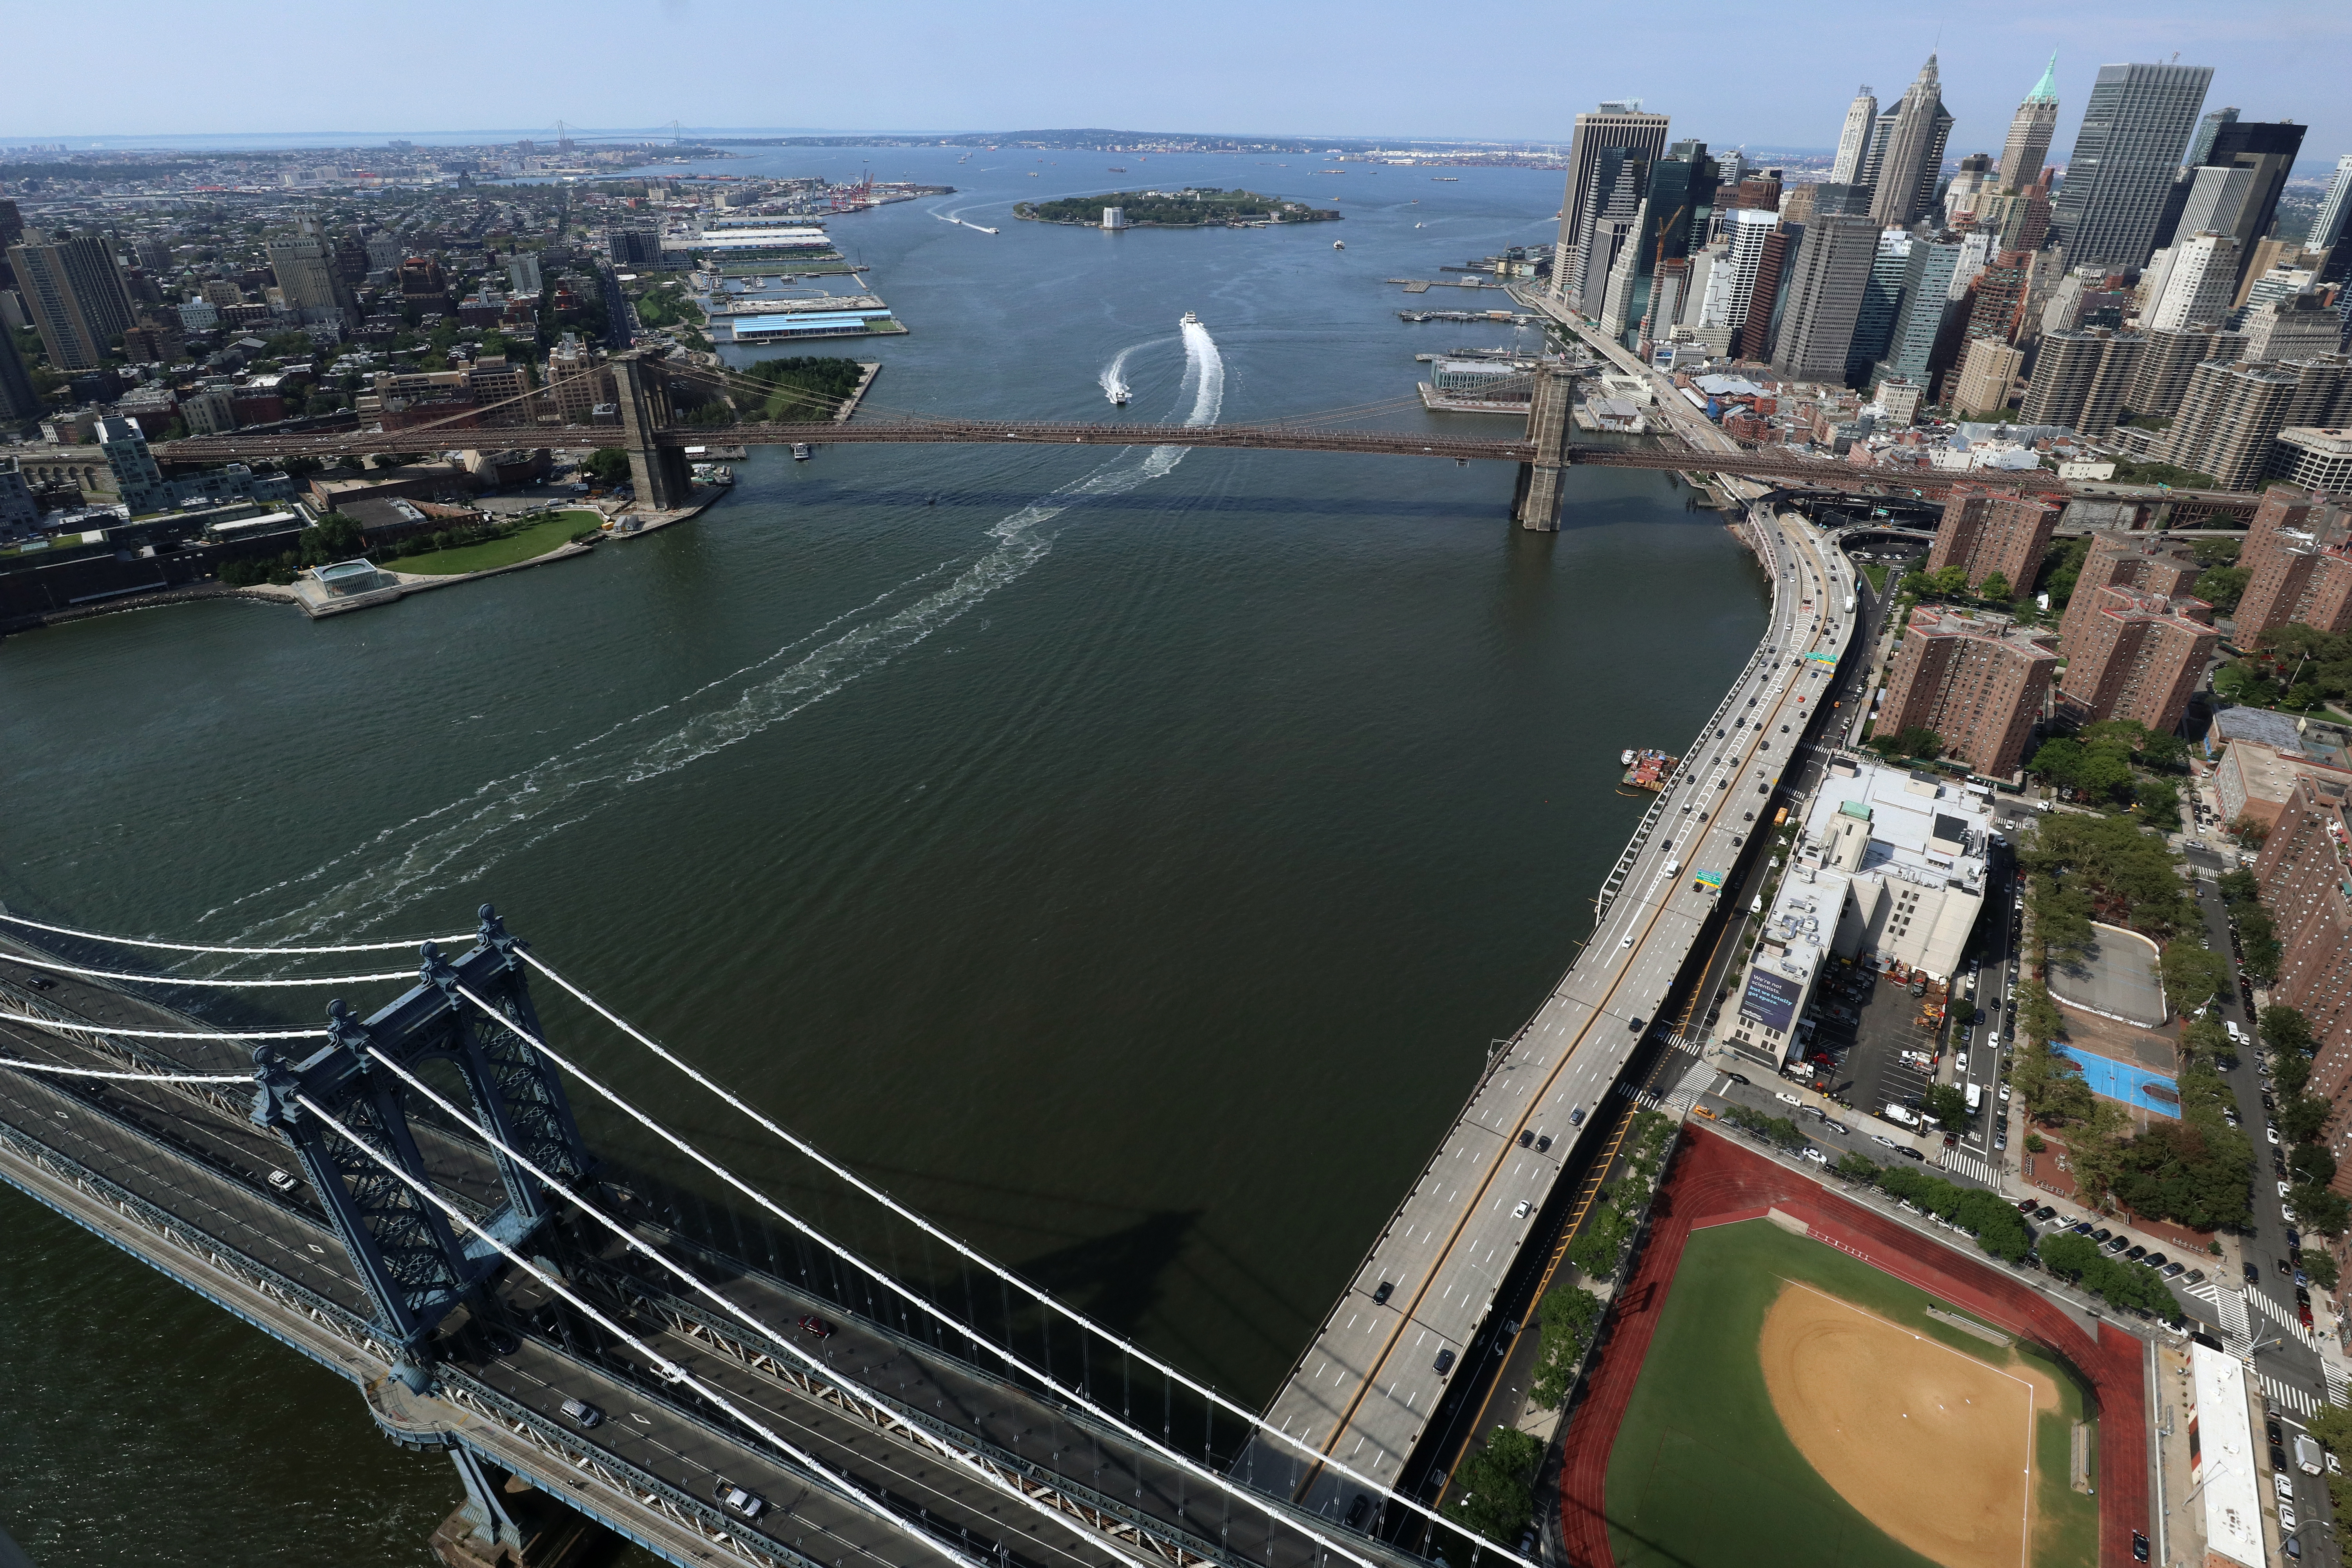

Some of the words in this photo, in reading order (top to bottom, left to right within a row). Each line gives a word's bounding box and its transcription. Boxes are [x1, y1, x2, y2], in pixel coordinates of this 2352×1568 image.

[1753, 975, 1771, 984] We're
[1751, 980, 1780, 995] scientists.
[1759, 995, 1778, 1005] space.
[1771, 994, 1793, 1005] totally
[1968, 1131, 1982, 1142] STOP
[1504, 1319, 1520, 1335] ONLY
[1429, 1468, 1446, 1487] ONLY
